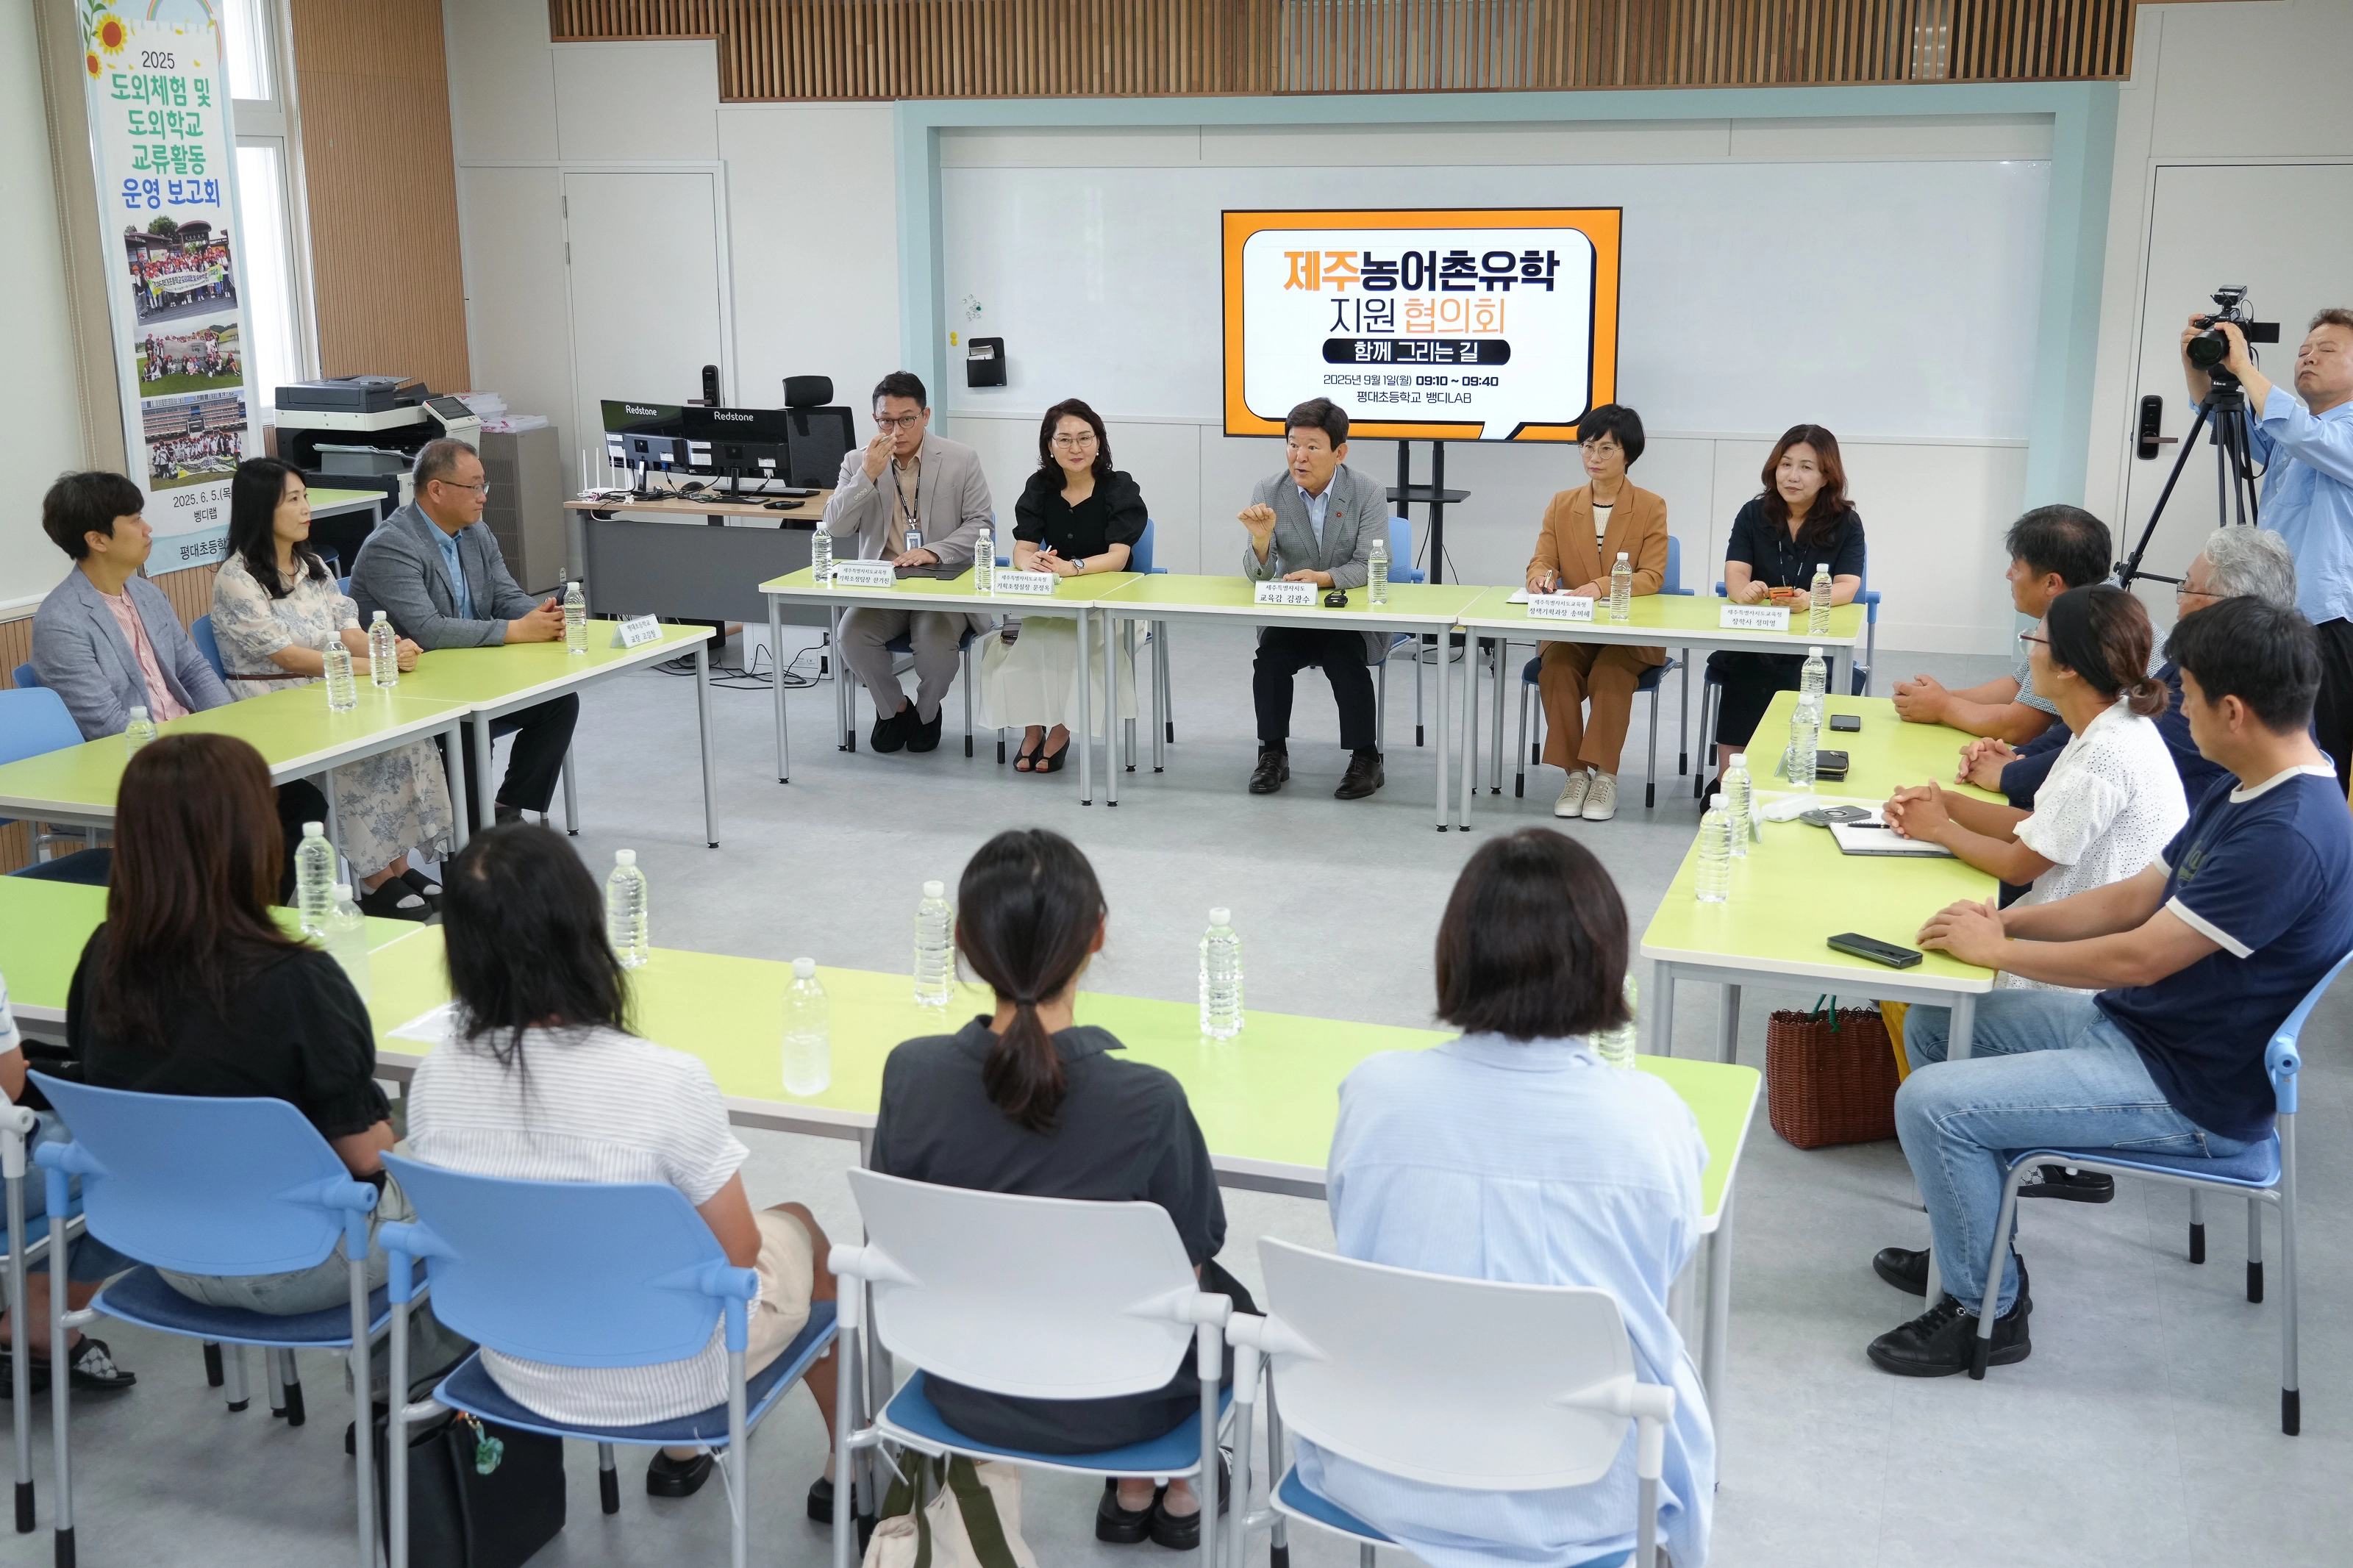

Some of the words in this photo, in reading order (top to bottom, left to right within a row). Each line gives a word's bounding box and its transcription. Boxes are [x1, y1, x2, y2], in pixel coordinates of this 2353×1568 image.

[142, 51, 174, 69] 2025
[111, 74, 187, 106] 도외체험
[194, 79, 211, 107] 및
[129, 110, 203, 140] 도외학교
[132, 145, 206, 175] 교류활동
[122, 179, 160, 209] 운영
[168, 179, 220, 207] 보고회
[1285, 251, 1560, 291] 제주농어촌유학
[1330, 298, 1394, 333] 지원
[1404, 298, 1504, 333] 협의회
[1354, 342, 1390, 361] 함께
[1397, 342, 1454, 362] 그리는
[1460, 343, 1477, 362] 길
[1324, 375, 1360, 385] 2025년
[1364, 375, 1380, 385] 9월
[1383, 376, 1411, 386] 1일(월)
[1416, 376, 1448, 385] 09:10
[1463, 376, 1499, 386] 09:40
[1357, 392, 1421, 403] 평대초등학교
[1427, 393, 1471, 404] 뱅디LAB
[626, 405, 657, 415] Redstone
[714, 412, 753, 421] Redstone
[174, 494, 198, 507] 2025.
[201, 492, 208, 503] 6.
[179, 537, 230, 560] 평대초등학
[1288, 595, 1310, 604] 김광수
[1530, 608, 1567, 616] 정책기획과장
[626, 620, 651, 632] 평대초등학교
[632, 634, 640, 642] 교장
